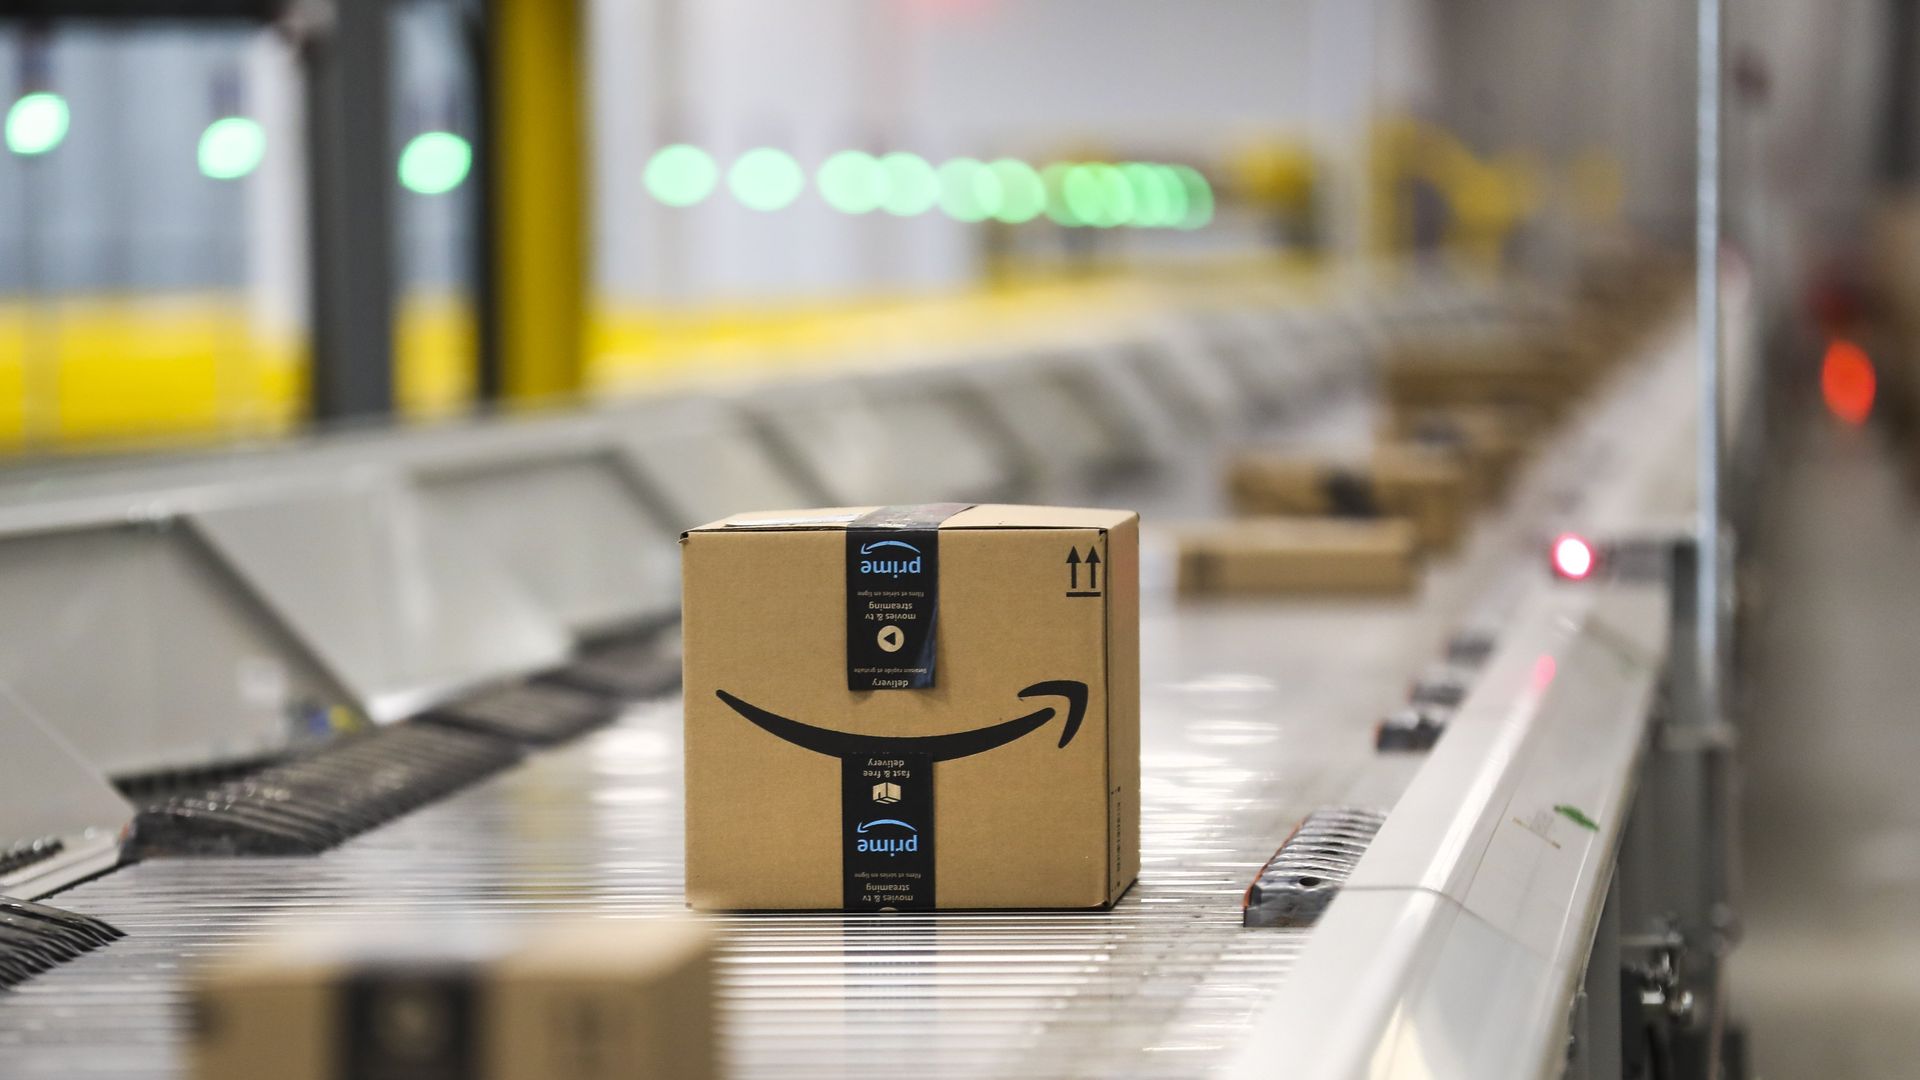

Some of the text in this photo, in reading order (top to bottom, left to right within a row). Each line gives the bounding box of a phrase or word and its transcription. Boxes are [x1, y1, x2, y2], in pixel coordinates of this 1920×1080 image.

[860, 557, 921, 578] prime
[868, 602, 912, 610] streaming
[872, 678, 908, 687] delivery
[868, 759, 904, 767] delivery
[863, 770, 910, 778] fast & free
[857, 835, 918, 856] prime
[866, 883, 909, 892] streaming
